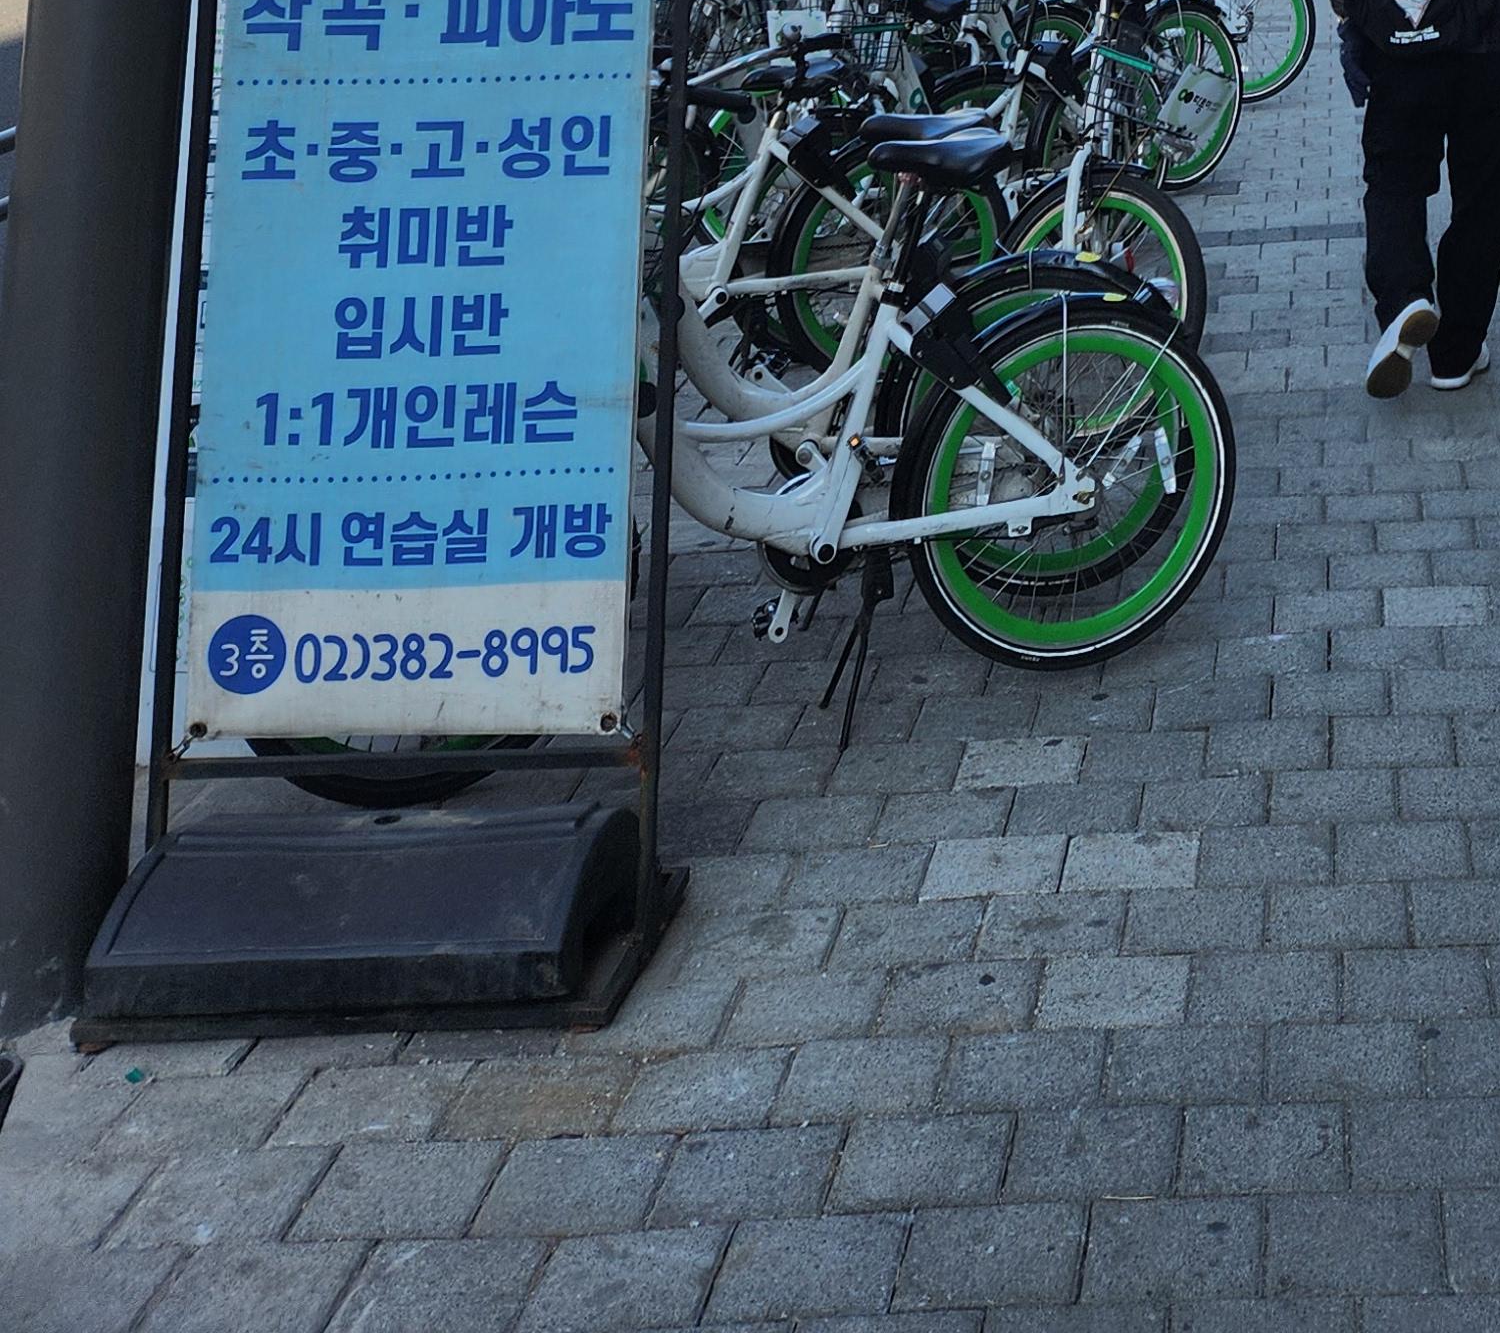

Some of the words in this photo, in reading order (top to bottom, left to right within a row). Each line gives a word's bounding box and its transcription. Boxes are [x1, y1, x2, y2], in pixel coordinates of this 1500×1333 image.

[337, 204, 513, 269] 취미반
[334, 292, 508, 360] 입시반
[255, 380, 577, 450] 1:1개인레슨
[210, 512, 320, 566] 24시
[341, 509, 488, 567] 연습실
[510, 502, 612, 559] 개방
[218, 629, 275, 679] 3층
[294, 625, 596, 684] 02)382-8995
